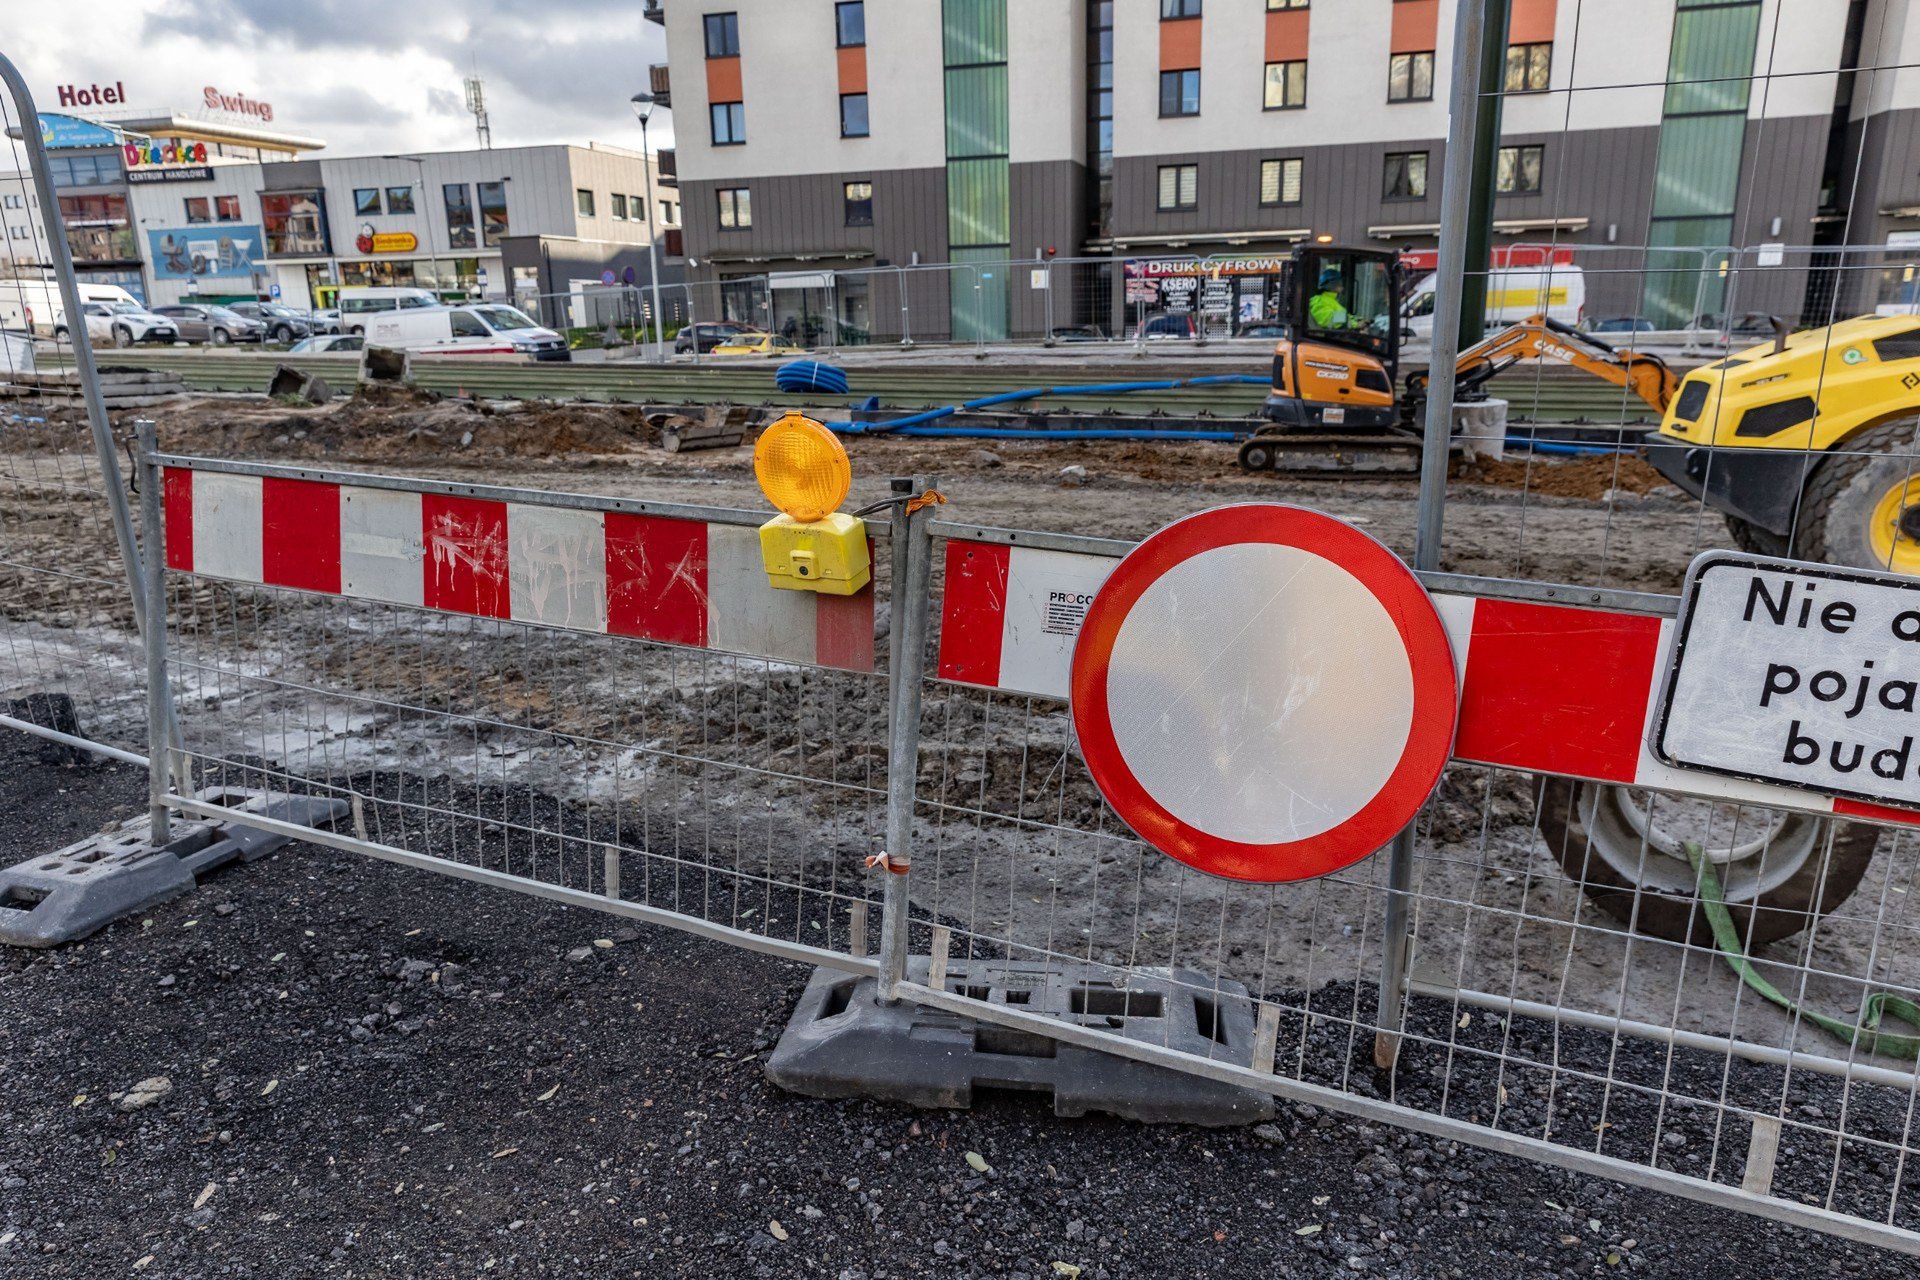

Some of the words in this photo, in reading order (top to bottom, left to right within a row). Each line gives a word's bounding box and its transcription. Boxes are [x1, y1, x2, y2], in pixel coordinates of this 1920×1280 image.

[57, 81, 126, 107] Hotel
[203, 86, 274, 122] Swing
[129, 171, 164, 182] CENTRUM
[165, 168, 206, 180] HANDLOWE
[1149, 261, 1195, 274] DRUK
[1201, 259, 1282, 272] CYFROWY
[1161, 277, 1197, 292] KSERO
[1533, 340, 1577, 362] CASE
[1743, 577, 1857, 633] Nie
[1759, 660, 1918, 719] poja
[1783, 720, 1920, 781] bud
